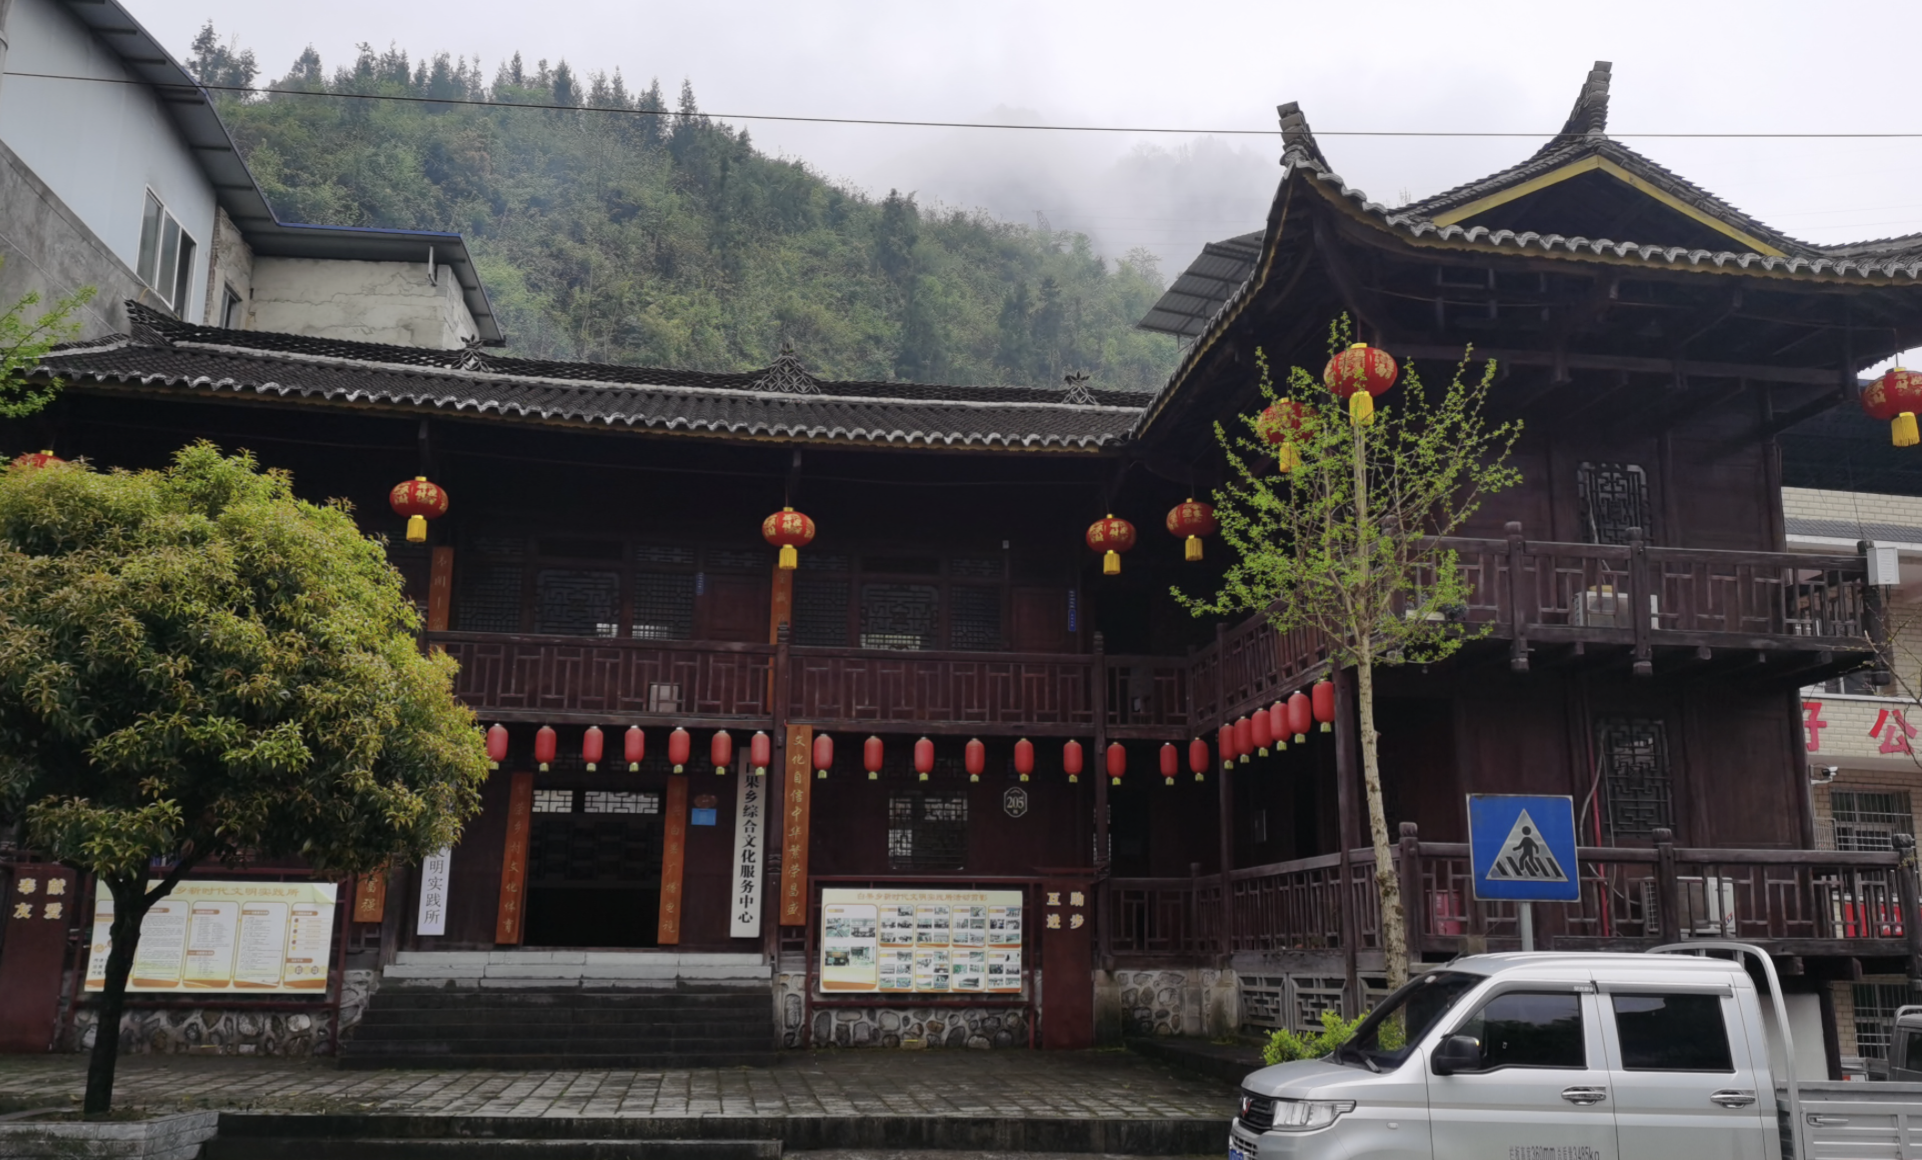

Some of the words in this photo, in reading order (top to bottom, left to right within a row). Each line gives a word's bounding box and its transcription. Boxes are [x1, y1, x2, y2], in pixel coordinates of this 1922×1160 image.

[1006, 796, 1025, 809] 205
[17, 877, 67, 895] 奉献
[145, 886, 300, 898] 乡新时代文明实践所
[1046, 891, 1085, 907] 互助
[13, 902, 63, 920] 友爱
[1046, 913, 1085, 930] 进步
